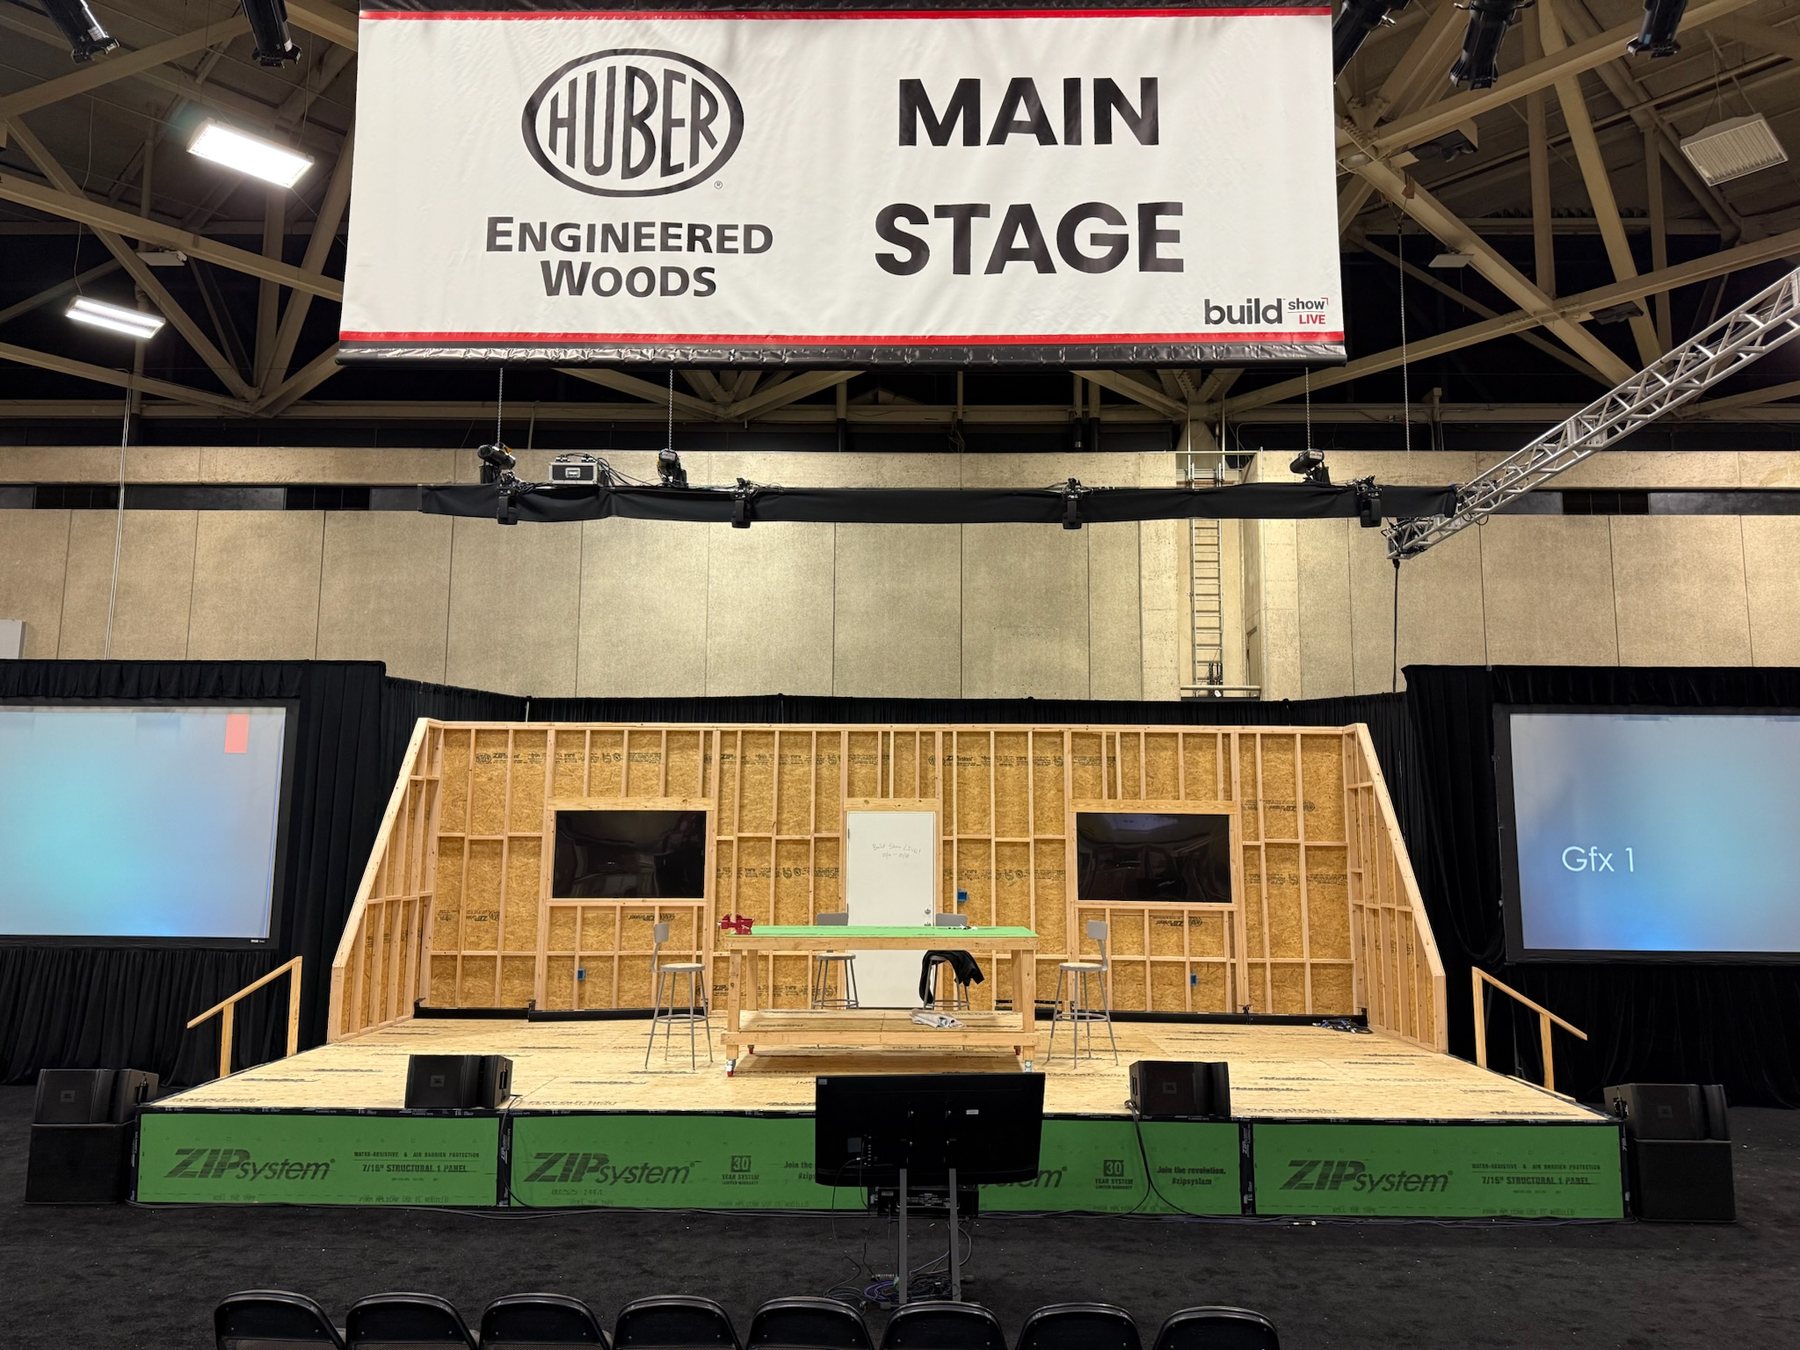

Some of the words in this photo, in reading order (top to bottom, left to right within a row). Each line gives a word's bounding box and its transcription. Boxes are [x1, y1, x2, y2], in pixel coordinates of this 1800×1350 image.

[899, 77, 1159, 146] MAIN
[548, 65, 719, 180] HUBER
[486, 216, 773, 254] ENGINEERED
[875, 202, 1184, 276] STAGE
[540, 260, 716, 298] WOODS
[1204, 298, 1283, 325] build
[1288, 298, 1325, 310] show
[1299, 314, 1326, 324] LIVE
[1561, 846, 1615, 873] Gfx
[1625, 847, 1634, 873] 1
[386, 1164, 433, 1173] STRUCTURAL
[443, 1164, 467, 1173] PANEL
[732, 1156, 750, 1171] 30
[783, 1161, 799, 1169] Join
[801, 1161, 813, 1169] the
[1105, 1160, 1123, 1176] 30
[1157, 1165, 1172, 1173] Join
[1174, 1165, 1185, 1173] the
[1506, 1176, 1554, 1185] STRUCTURAL
